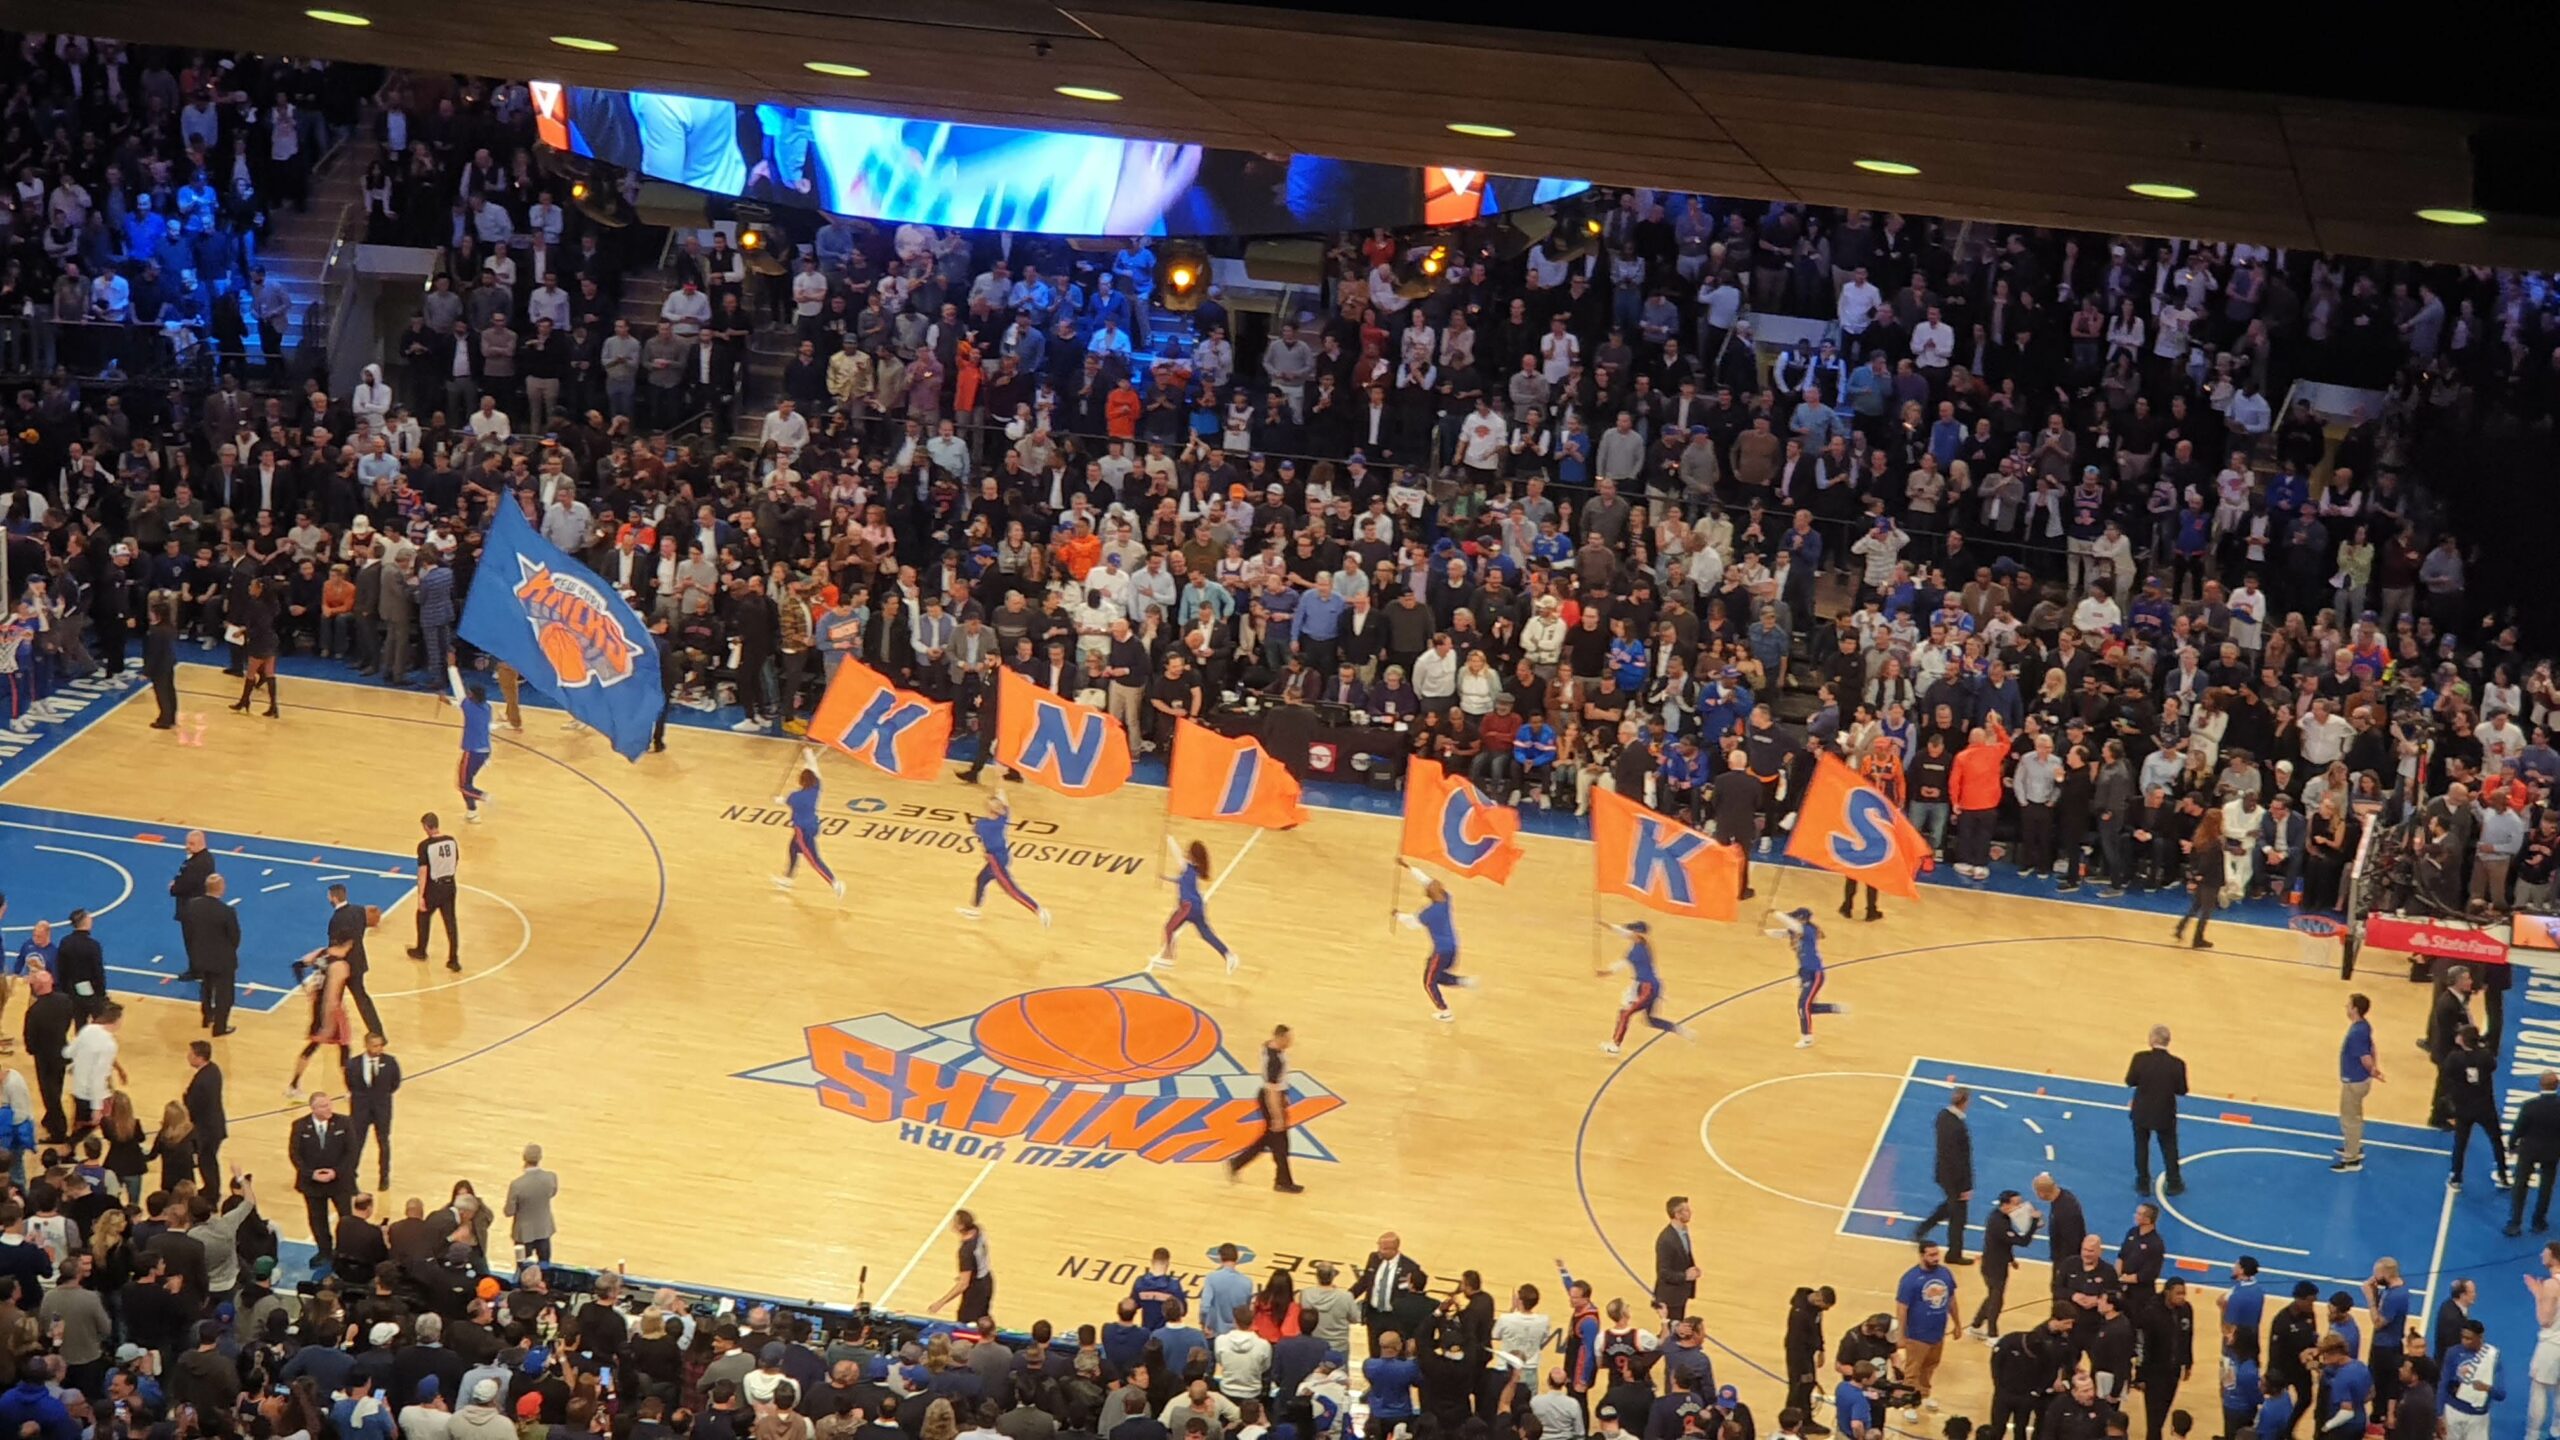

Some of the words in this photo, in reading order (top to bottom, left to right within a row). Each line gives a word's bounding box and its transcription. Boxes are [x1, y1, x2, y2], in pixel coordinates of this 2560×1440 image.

[839, 688, 932, 775] K
[1015, 700, 1105, 788] N
[438, 844, 452, 859] 48
[854, 821, 982, 854] SQUARE
[1438, 784, 1504, 869] C
[1624, 812, 1716, 907] K
[1827, 786, 1896, 869] S
[804, 1025, 1346, 1163] KNICKS
[899, 1121, 1006, 1162] YORK
[1012, 1145, 1129, 1170] NEW
